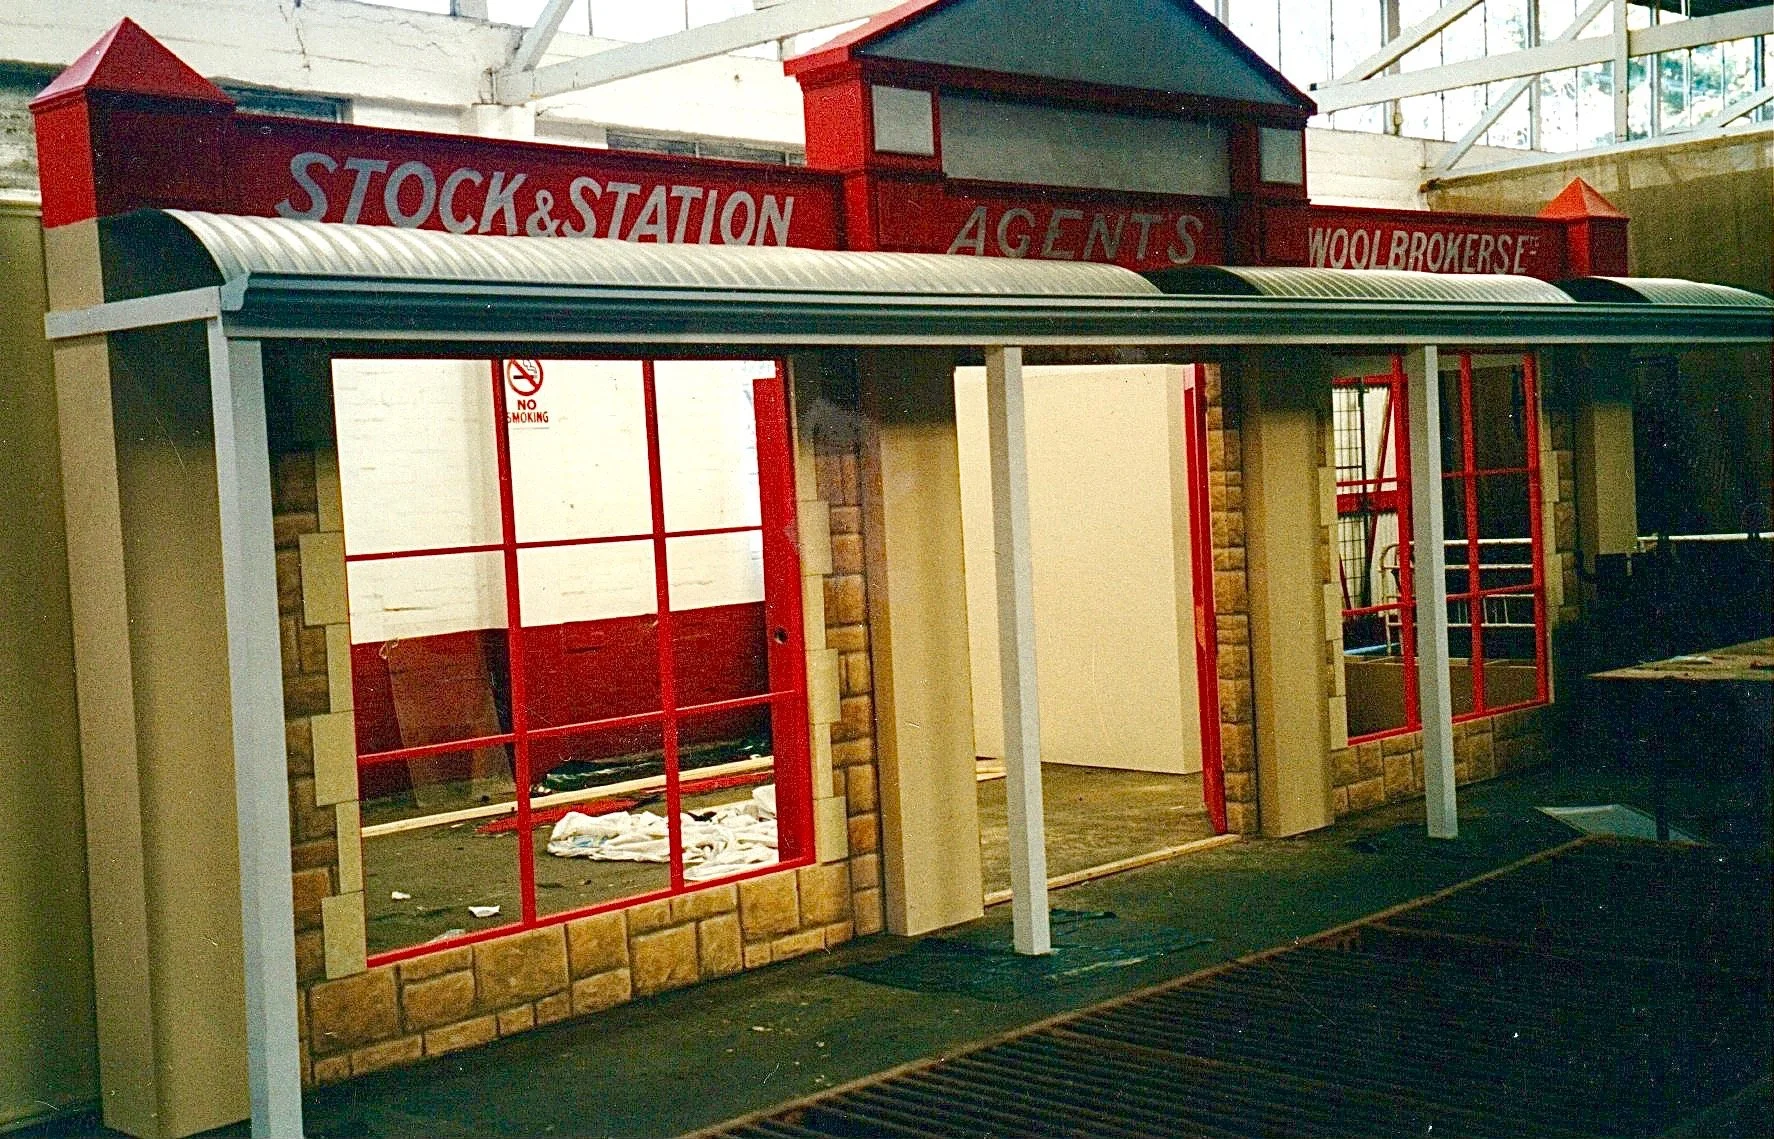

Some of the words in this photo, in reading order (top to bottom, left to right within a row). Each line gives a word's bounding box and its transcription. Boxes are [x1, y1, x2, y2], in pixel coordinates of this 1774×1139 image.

[274, 152, 528, 236] STOCK
[561, 176, 794, 247] STATION
[946, 205, 1203, 264] AGENTS
[507, 411, 549, 424] SMOKING
[517, 399, 537, 411] NO
